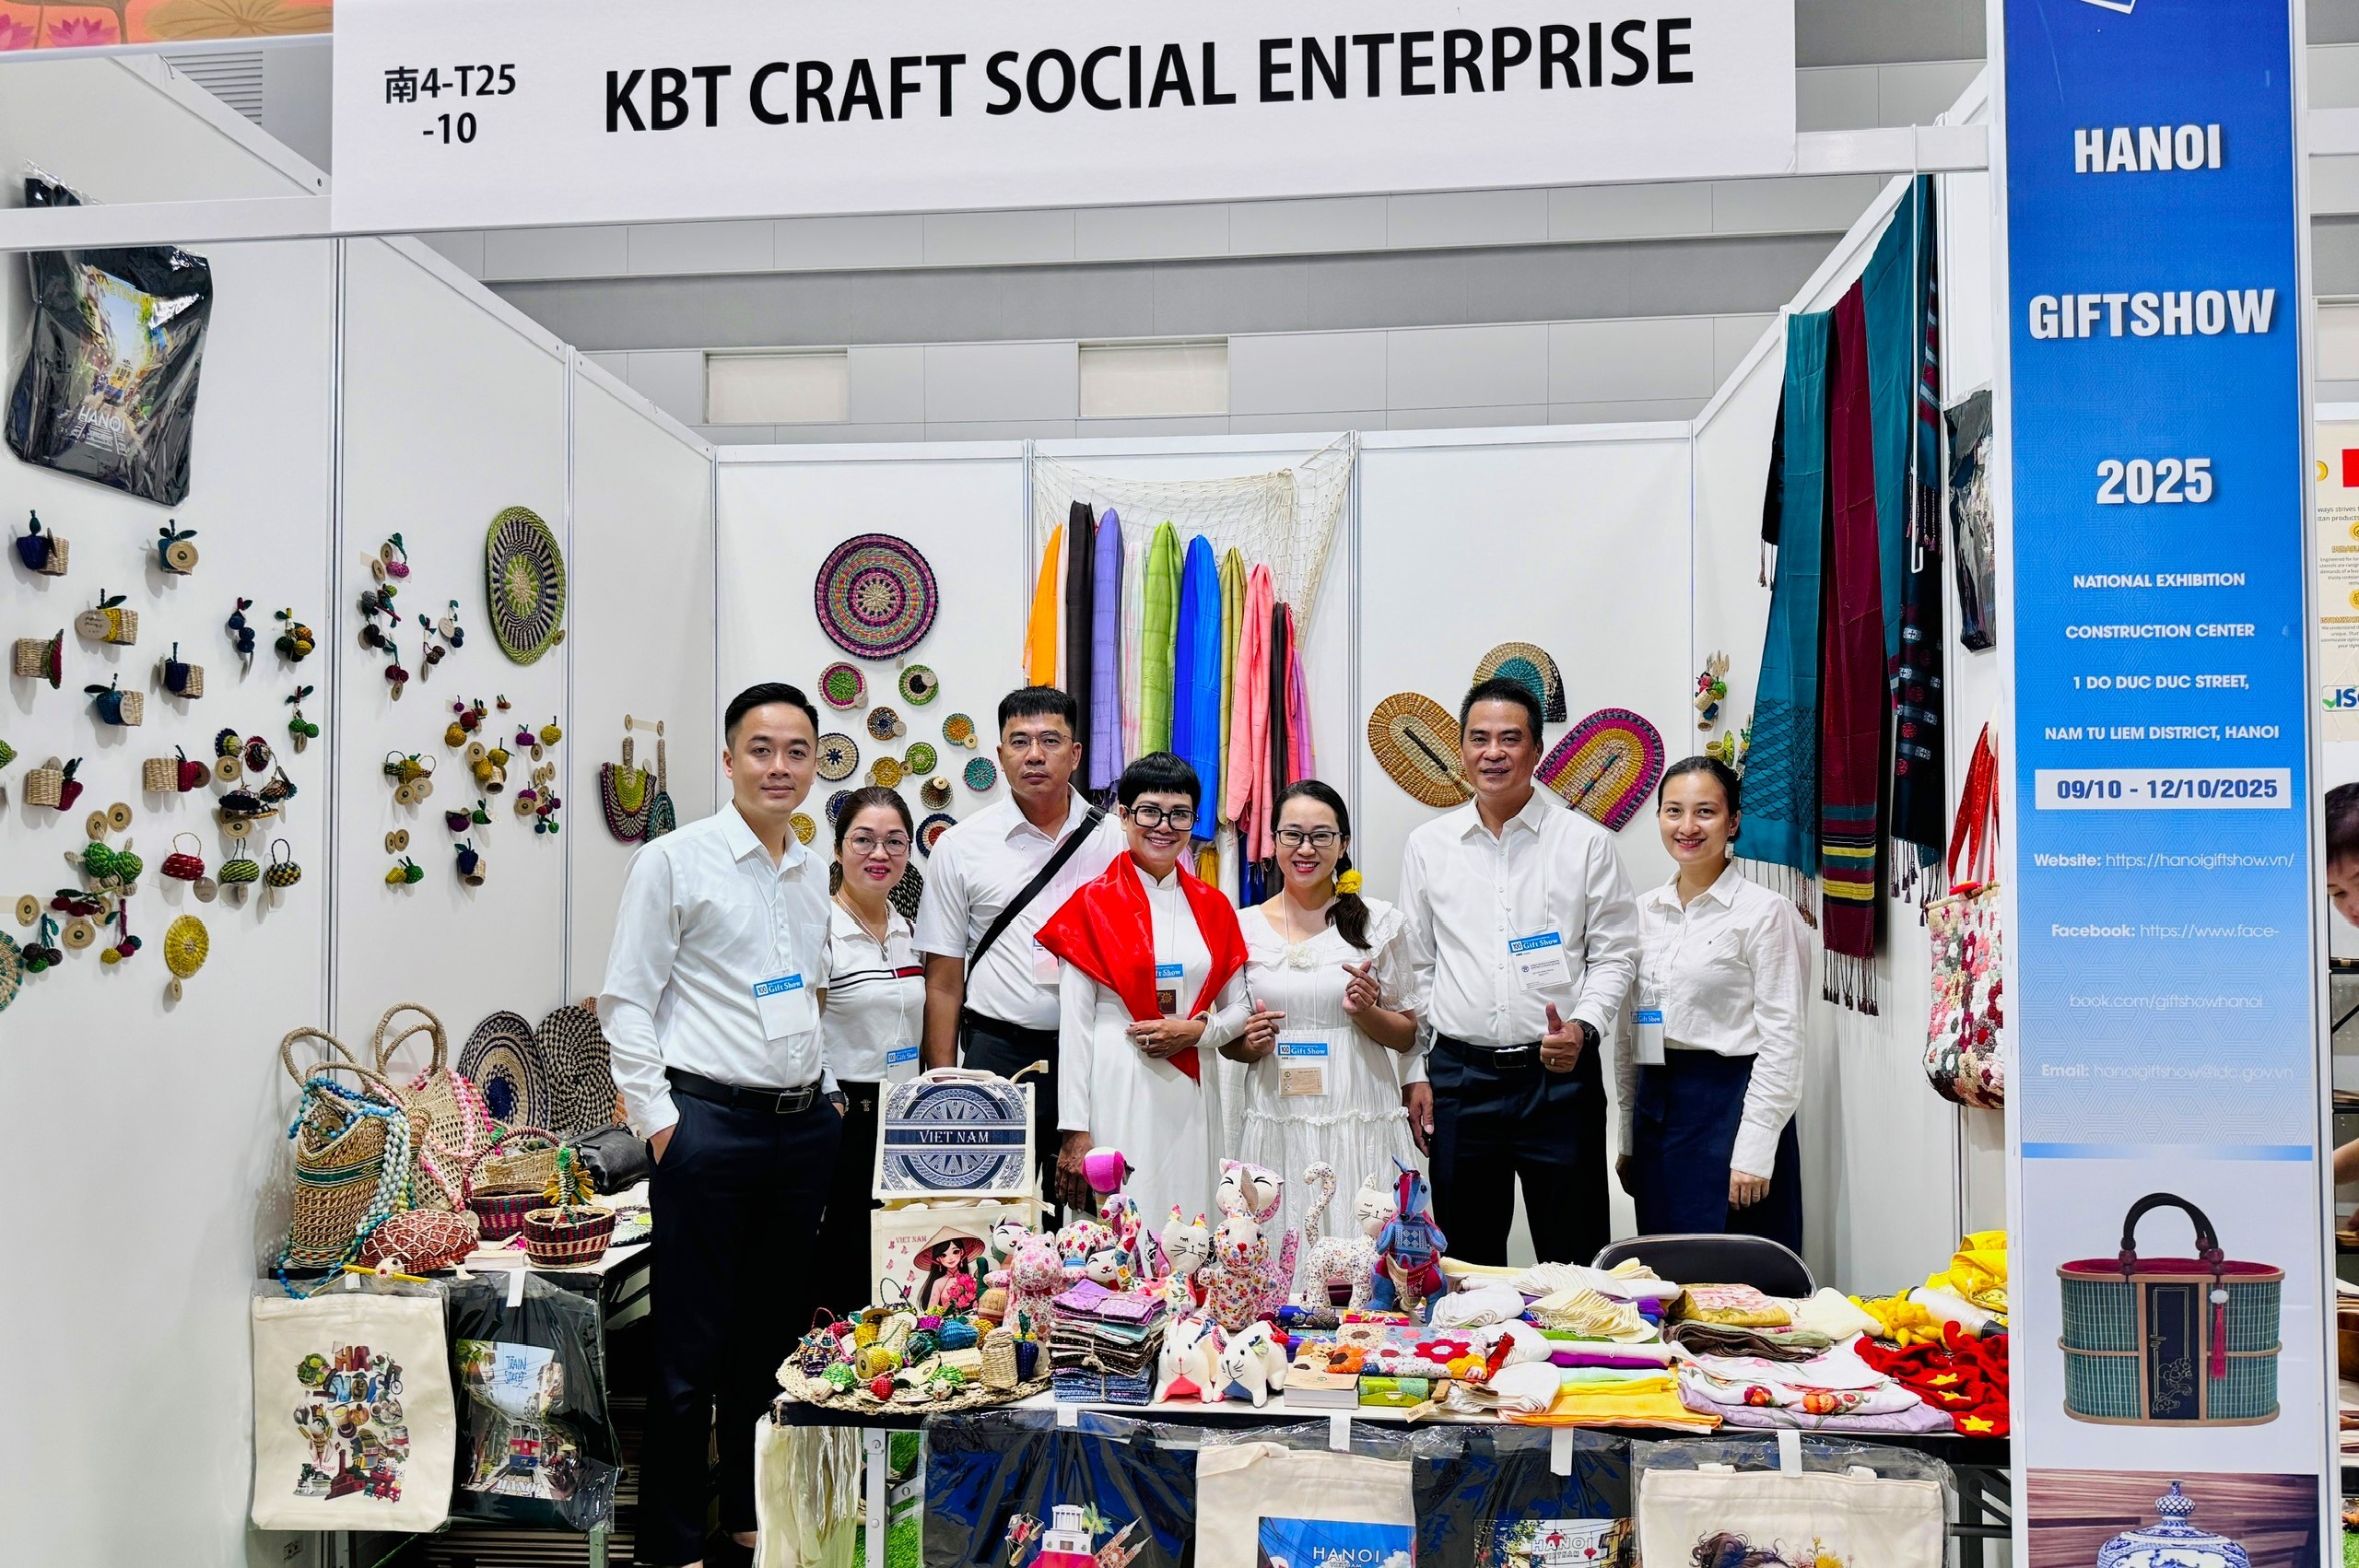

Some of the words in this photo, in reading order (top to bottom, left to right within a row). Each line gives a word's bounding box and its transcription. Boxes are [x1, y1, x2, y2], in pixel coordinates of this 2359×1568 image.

[605, 64, 732, 133] KBT
[749, 53, 967, 125] CRAFT
[985, 41, 1237, 116] SOCIAL
[1259, 18, 1694, 103] ENTERPRISE
[385, 64, 516, 104] 南4-T25
[422, 111, 477, 145] -10
[2074, 124, 2221, 173] HANOI
[2029, 288, 2275, 339] GIFTSHOW
[78, 405, 125, 434] HANOI
[2096, 457, 2213, 505] 2025
[2073, 573, 2153, 588] NATIONAL
[2156, 573, 2246, 588] EXHIBITION
[2065, 624, 2191, 639] CONSTRUCTION
[2196, 623, 2255, 638] CENTER
[2073, 676, 2080, 689] 1
[2086, 675, 2112, 689] DO
[2116, 675, 2152, 689] DUC
[2155, 674, 2191, 689] DUC
[2195, 673, 2249, 690] STREET,
[2336, 688, 2359, 708] IS
[2045, 727, 2083, 740] NAM
[2086, 727, 2106, 740] TU
[2110, 726, 2144, 740] LIEM
[2149, 725, 2221, 742] DISTRICT,
[2225, 725, 2279, 740] HANOI
[2057, 779, 2122, 800] 09/10
[2146, 778, 2278, 800] 12/10/2025
[2034, 853, 2101, 867] Website:
[2106, 853, 2294, 870] https://hanoigiftshow.vn/
[2051, 924, 2135, 937] Facebook:
[2140, 924, 2280, 940] https://www.face-
[1523, 942, 1538, 950] Gift
[1539, 939, 1558, 947] Show
[1162, 968, 1180, 977] Show
[769, 984, 783, 993] Gift
[783, 980, 802, 989] Show
[2070, 995, 2263, 1011] book.com/giftshowhanoi
[1291, 1047, 1307, 1055] Gift
[1308, 1047, 1326, 1055] Show
[2041, 1064, 2089, 1077] Email:
[920, 1129, 953, 1143] VIET
[957, 1131, 990, 1143] NAM
[896, 1235, 910, 1244] VIET
[912, 1235, 927, 1243] NAM
[505, 1355, 527, 1370] TRAIN
[1531, 1536, 1595, 1552] HANOI
[1312, 1546, 1380, 1563] HANOI
